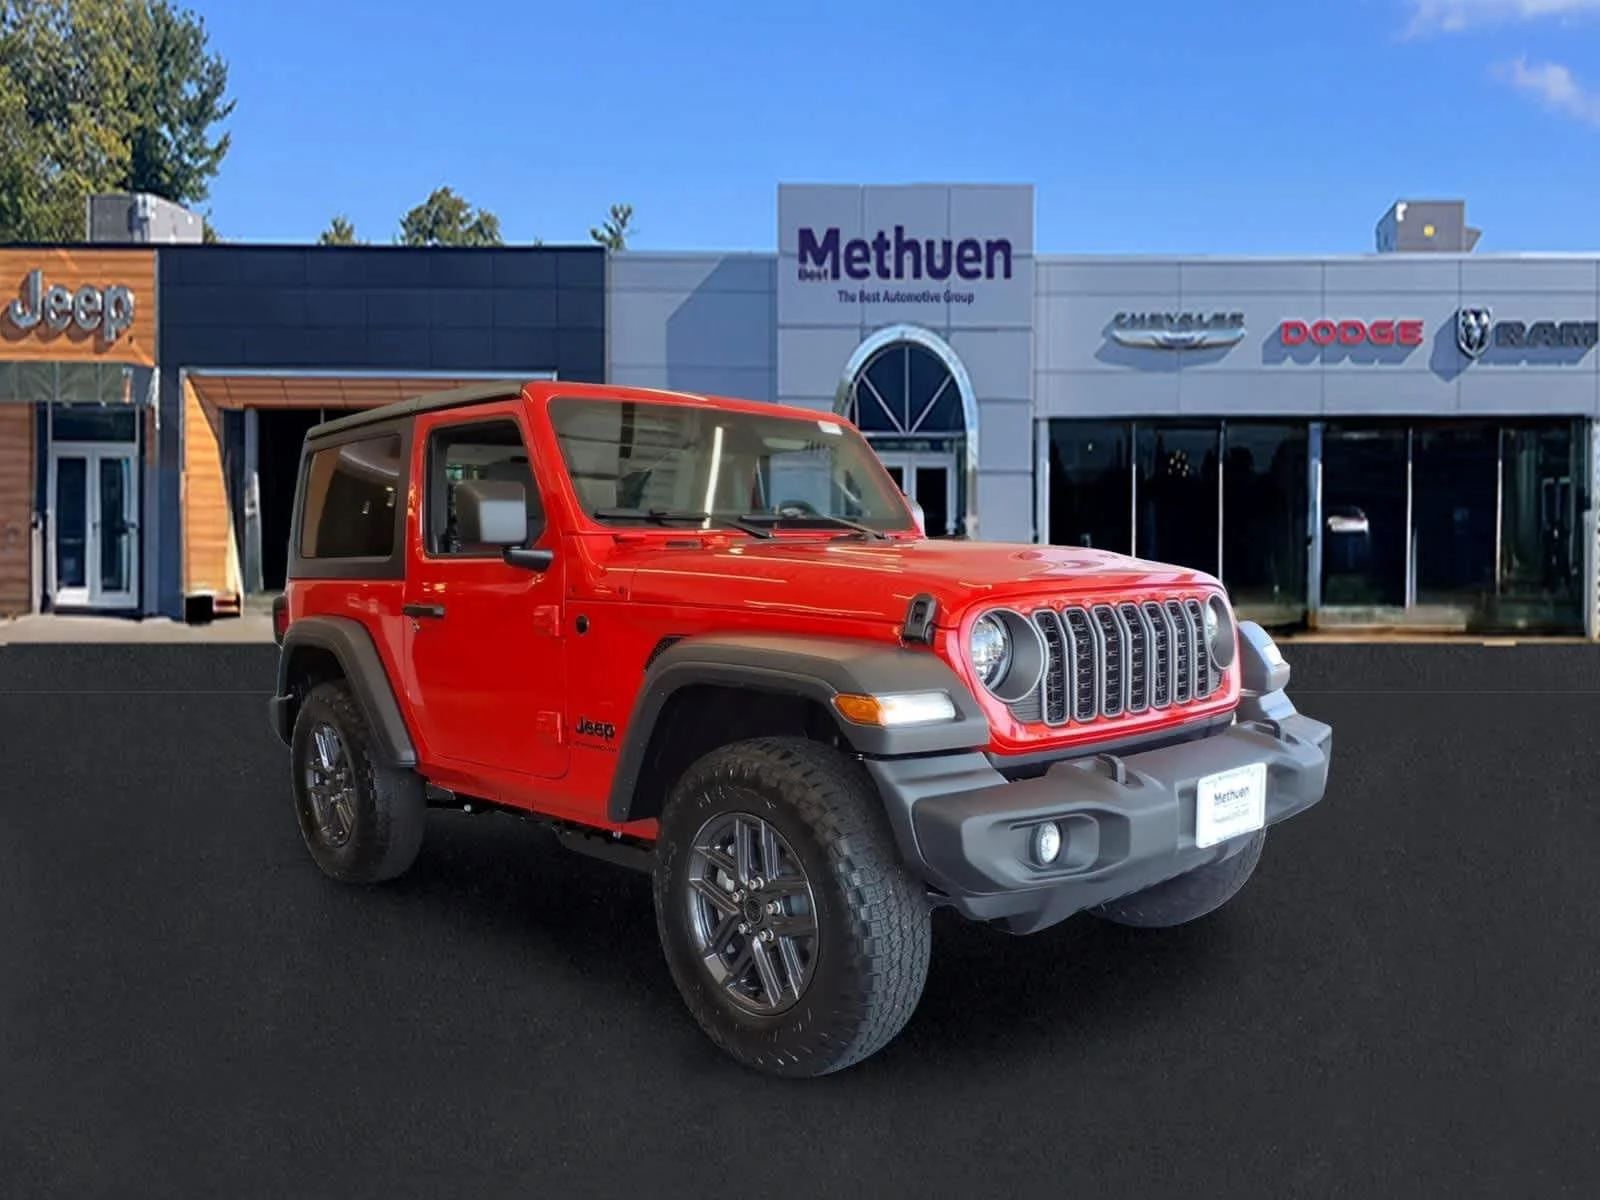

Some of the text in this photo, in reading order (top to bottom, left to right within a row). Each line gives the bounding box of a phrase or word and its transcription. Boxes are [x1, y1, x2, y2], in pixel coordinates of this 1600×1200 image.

[798, 225, 1012, 281] Methuen
[9, 270, 135, 342] Jeep
[838, 289, 974, 305] The Best Automotive Group
[1280, 319, 1424, 346] DODGE
[575, 715, 616, 742] Jeep
[1213, 786, 1250, 803] Methuen
